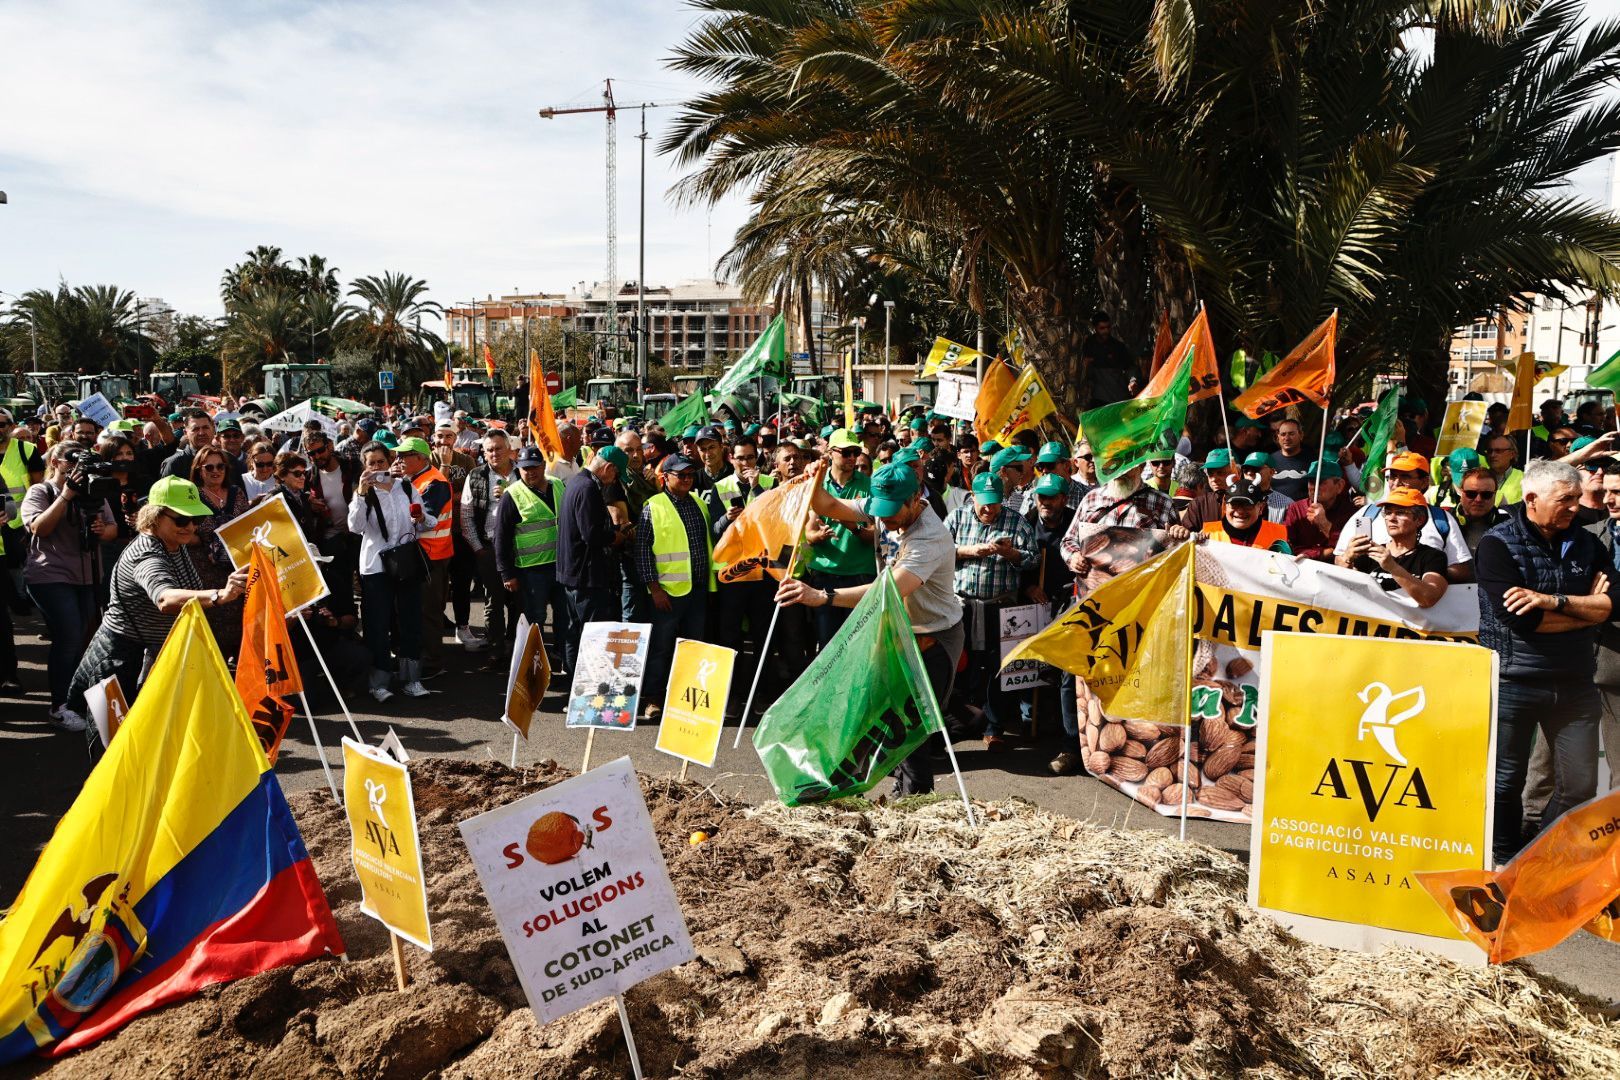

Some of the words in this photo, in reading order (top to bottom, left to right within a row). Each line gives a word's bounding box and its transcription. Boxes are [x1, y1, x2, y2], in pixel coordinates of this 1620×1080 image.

[680, 686, 711, 712] AVA
[1311, 757, 1437, 823] AVA
[365, 818, 402, 859] AVA
[1269, 832, 1395, 861] D'AGRICULTORS
[1270, 816, 1363, 841] ASSOCIACIÓ
[1370, 830, 1475, 856] VALENCIANA
[539, 861, 612, 902] VOLEM
[1326, 866, 1412, 890] ASAJA
[522, 871, 646, 938] SOLUCIONS
[544, 914, 656, 978] COTONET
[581, 918, 608, 937] AL
[541, 983, 568, 1004] DE
[570, 934, 675, 991] SUD-ÀFRICA
